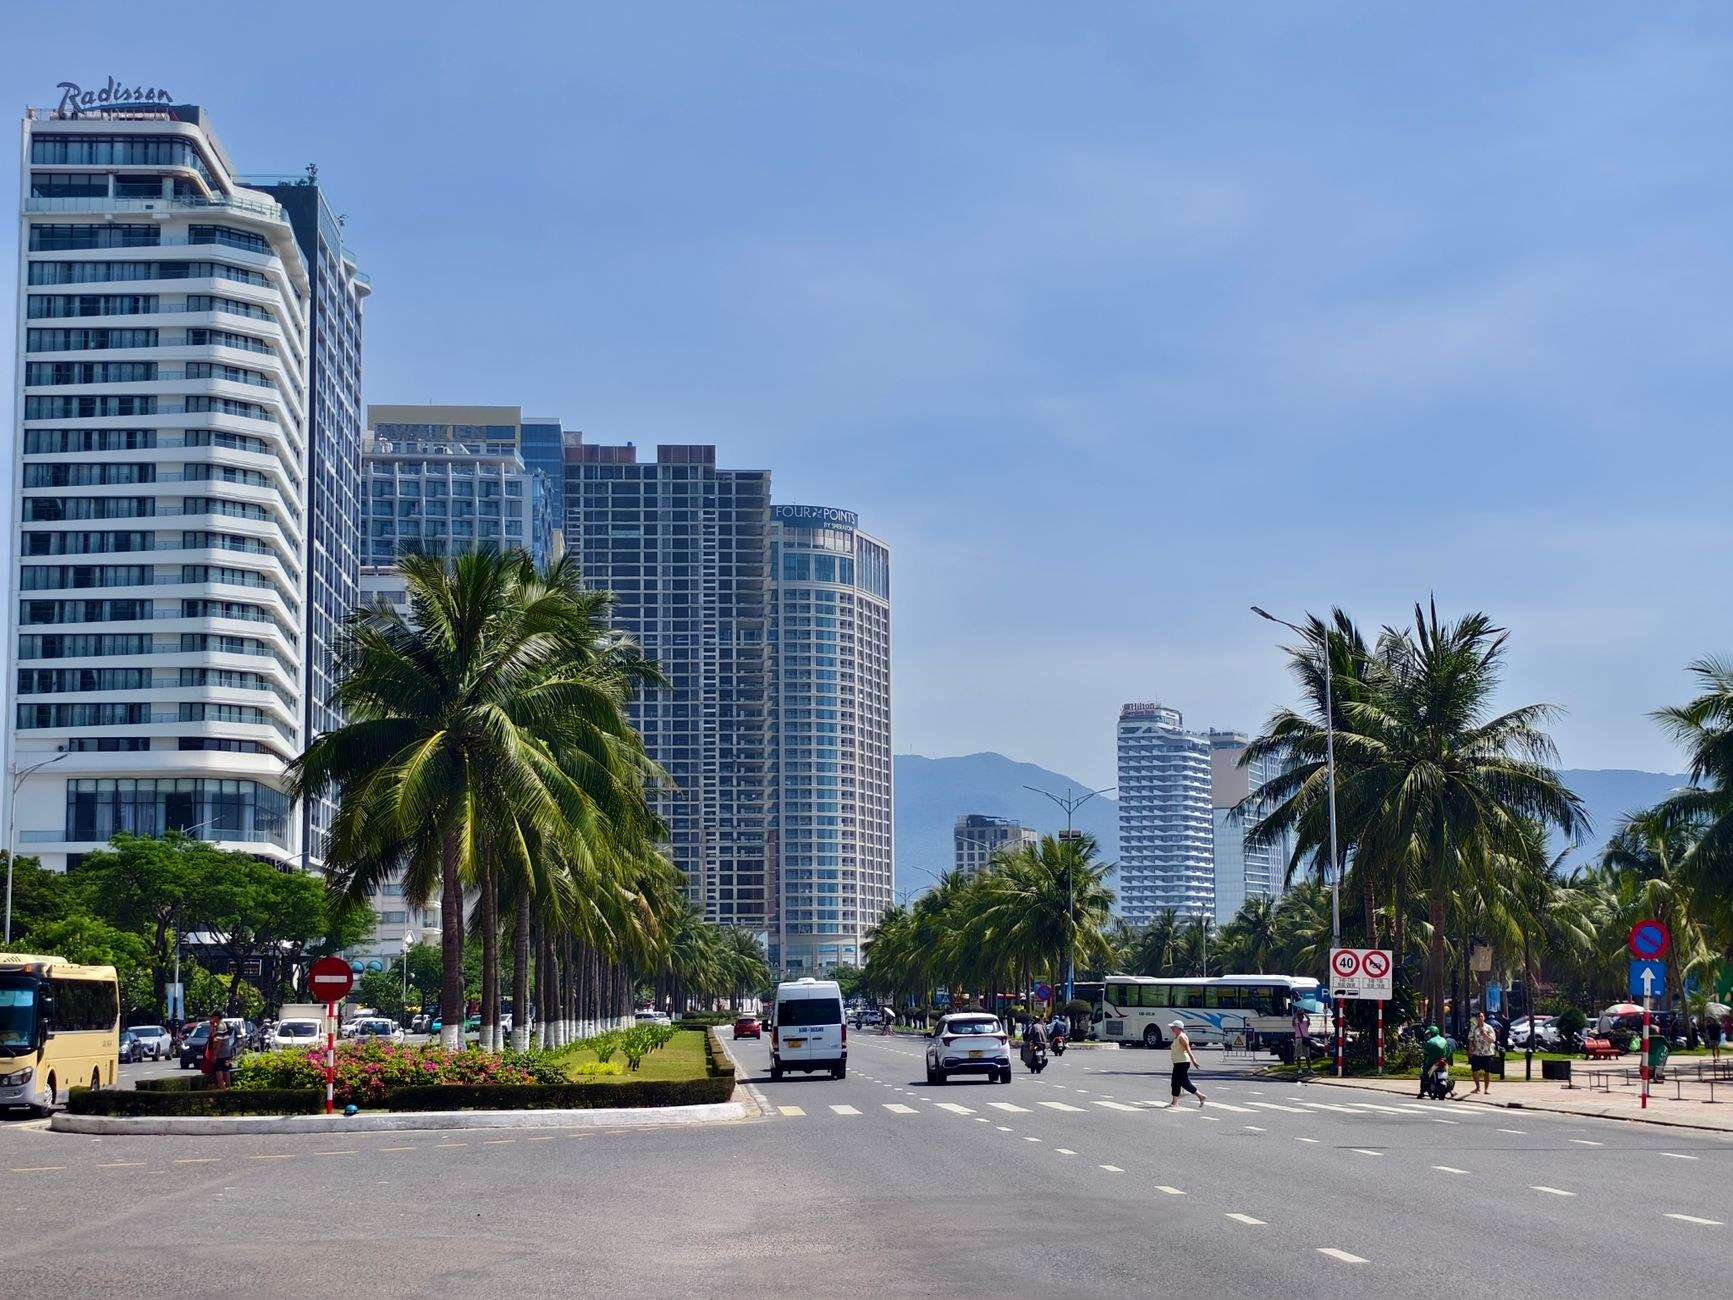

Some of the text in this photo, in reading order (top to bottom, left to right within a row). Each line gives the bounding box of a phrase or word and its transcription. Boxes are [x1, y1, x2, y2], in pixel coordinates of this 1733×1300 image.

[57, 75, 174, 116] Radisson
[776, 506, 855, 524] FOUR POINTS
[1130, 702, 1155, 710] Hilton
[1340, 957, 1354, 969] 40
[1321, 988, 1330, 998] P
